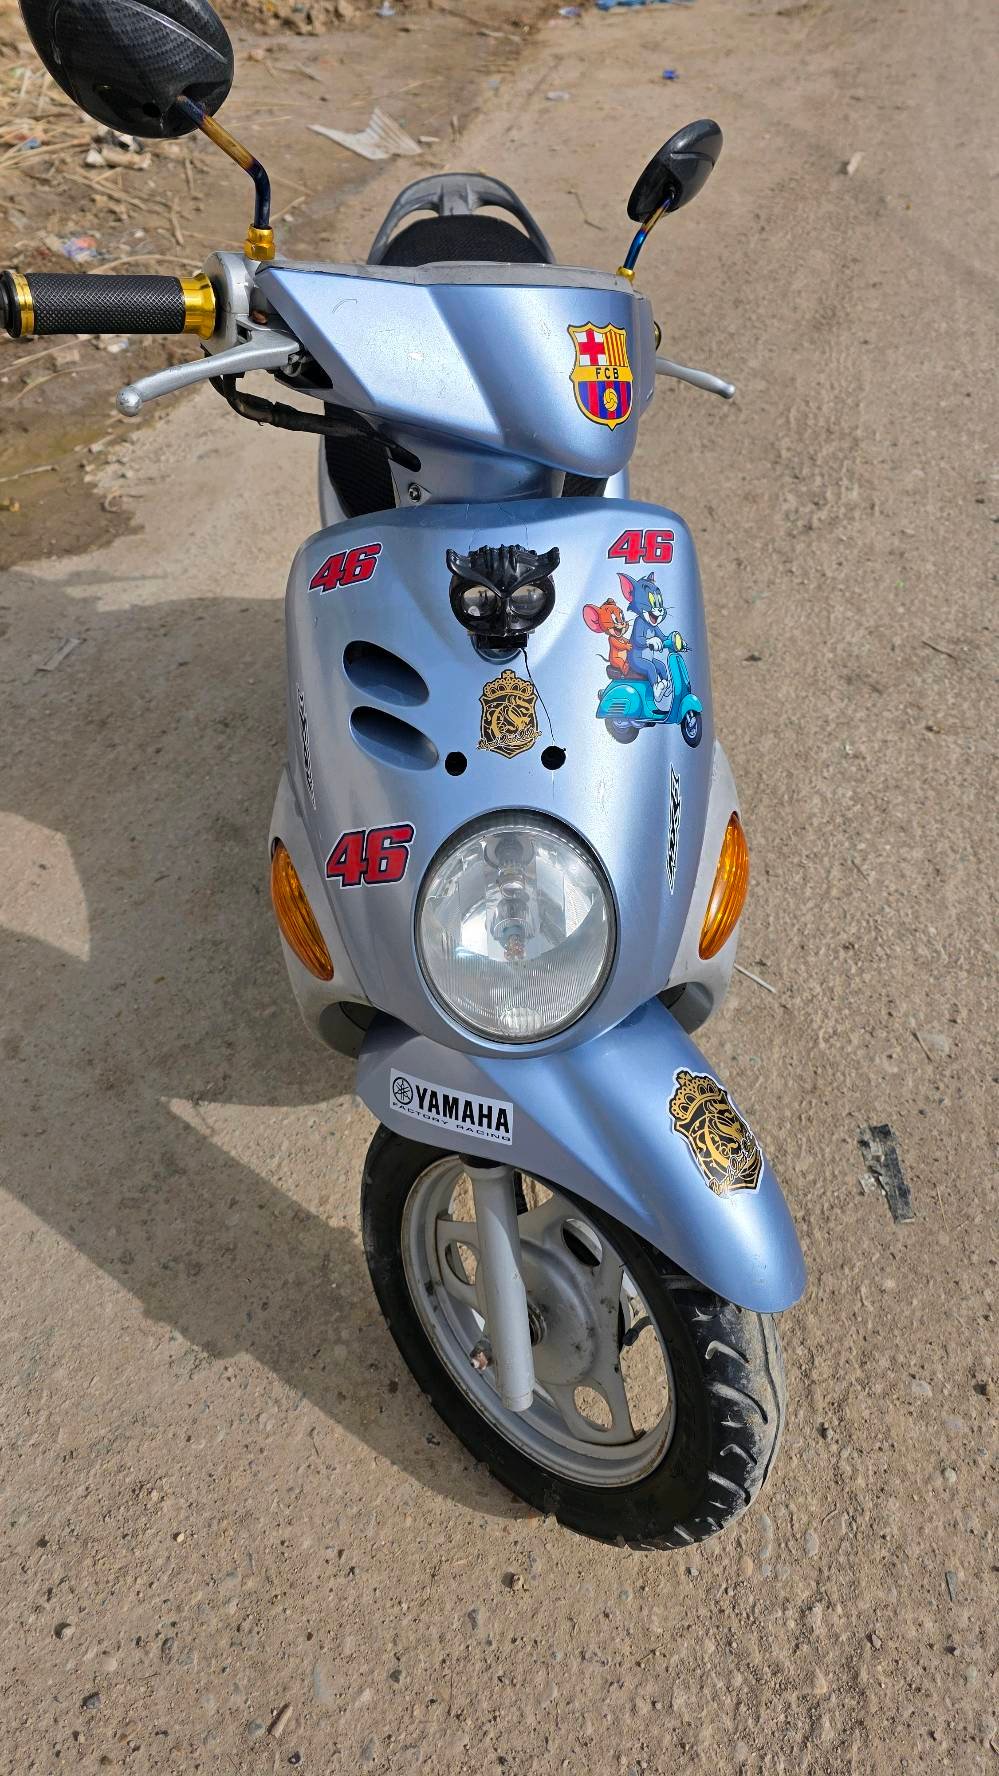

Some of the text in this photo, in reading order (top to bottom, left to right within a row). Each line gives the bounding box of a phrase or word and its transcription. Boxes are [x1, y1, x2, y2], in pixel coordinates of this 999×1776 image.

[595, 367, 620, 380] FCB
[307, 542, 382, 595] 46
[607, 529, 675, 565] 46
[325, 822, 415, 888] 46
[392, 1101, 511, 1142] FACTORY RACING
[415, 1084, 510, 1134] YAMAHA
